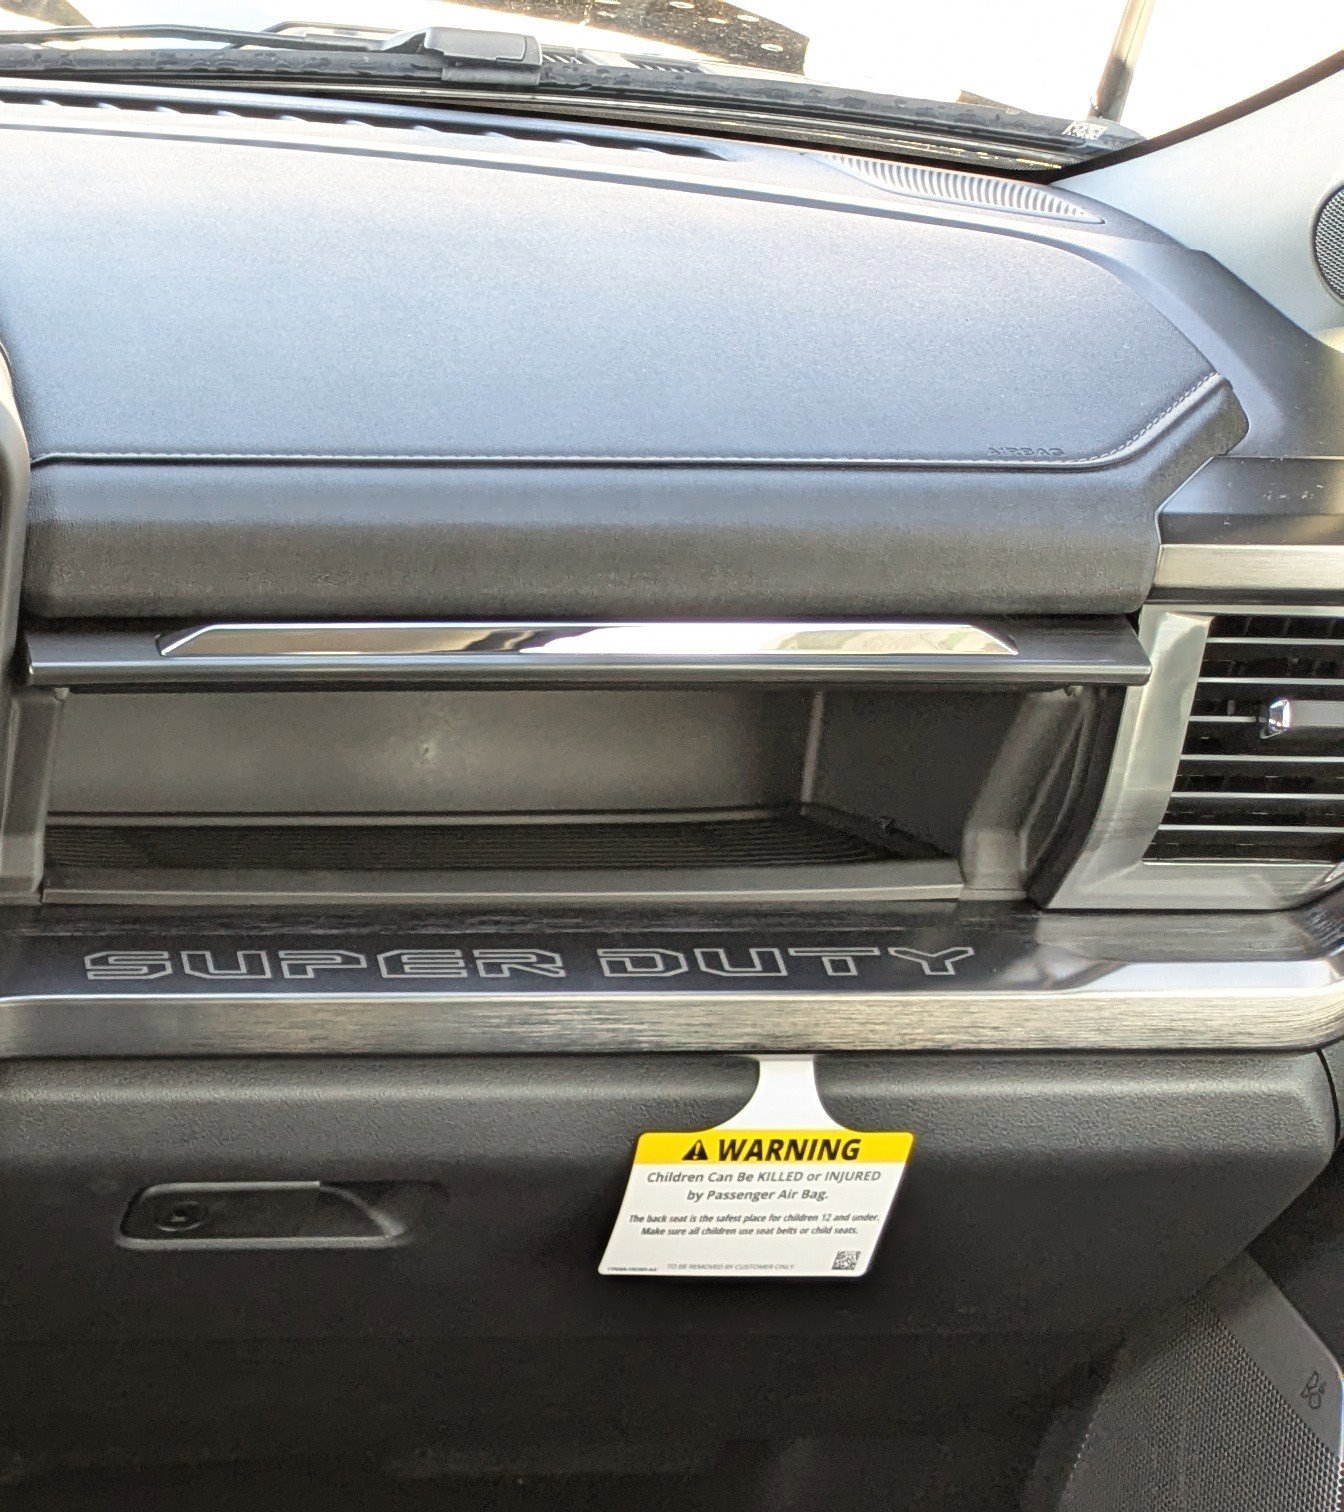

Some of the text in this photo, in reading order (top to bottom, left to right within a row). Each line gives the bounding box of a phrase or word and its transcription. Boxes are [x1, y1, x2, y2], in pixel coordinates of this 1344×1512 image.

[83, 946, 974, 980] SUPER DUTY
[717, 1138, 862, 1162] WARNING
[647, 1171, 881, 1183] Children Can Be KILLED or INJURED
[686, 1189, 828, 1203] by Passenger Air Bag.
[629, 1213, 880, 1224] The back seat is the safest place for children 12 and under.
[641, 1227, 665, 1236] Make
[667, 1228, 686, 1236] sure
[688, 1227, 700, 1236] all
[702, 1227, 736, 1236] children
[738, 1228, 753, 1236] use
[756, 1227, 775, 1235] seat
[776, 1227, 797, 1235] belts
[812, 1227, 832, 1235] child
[834, 1227, 858, 1235] seats.
